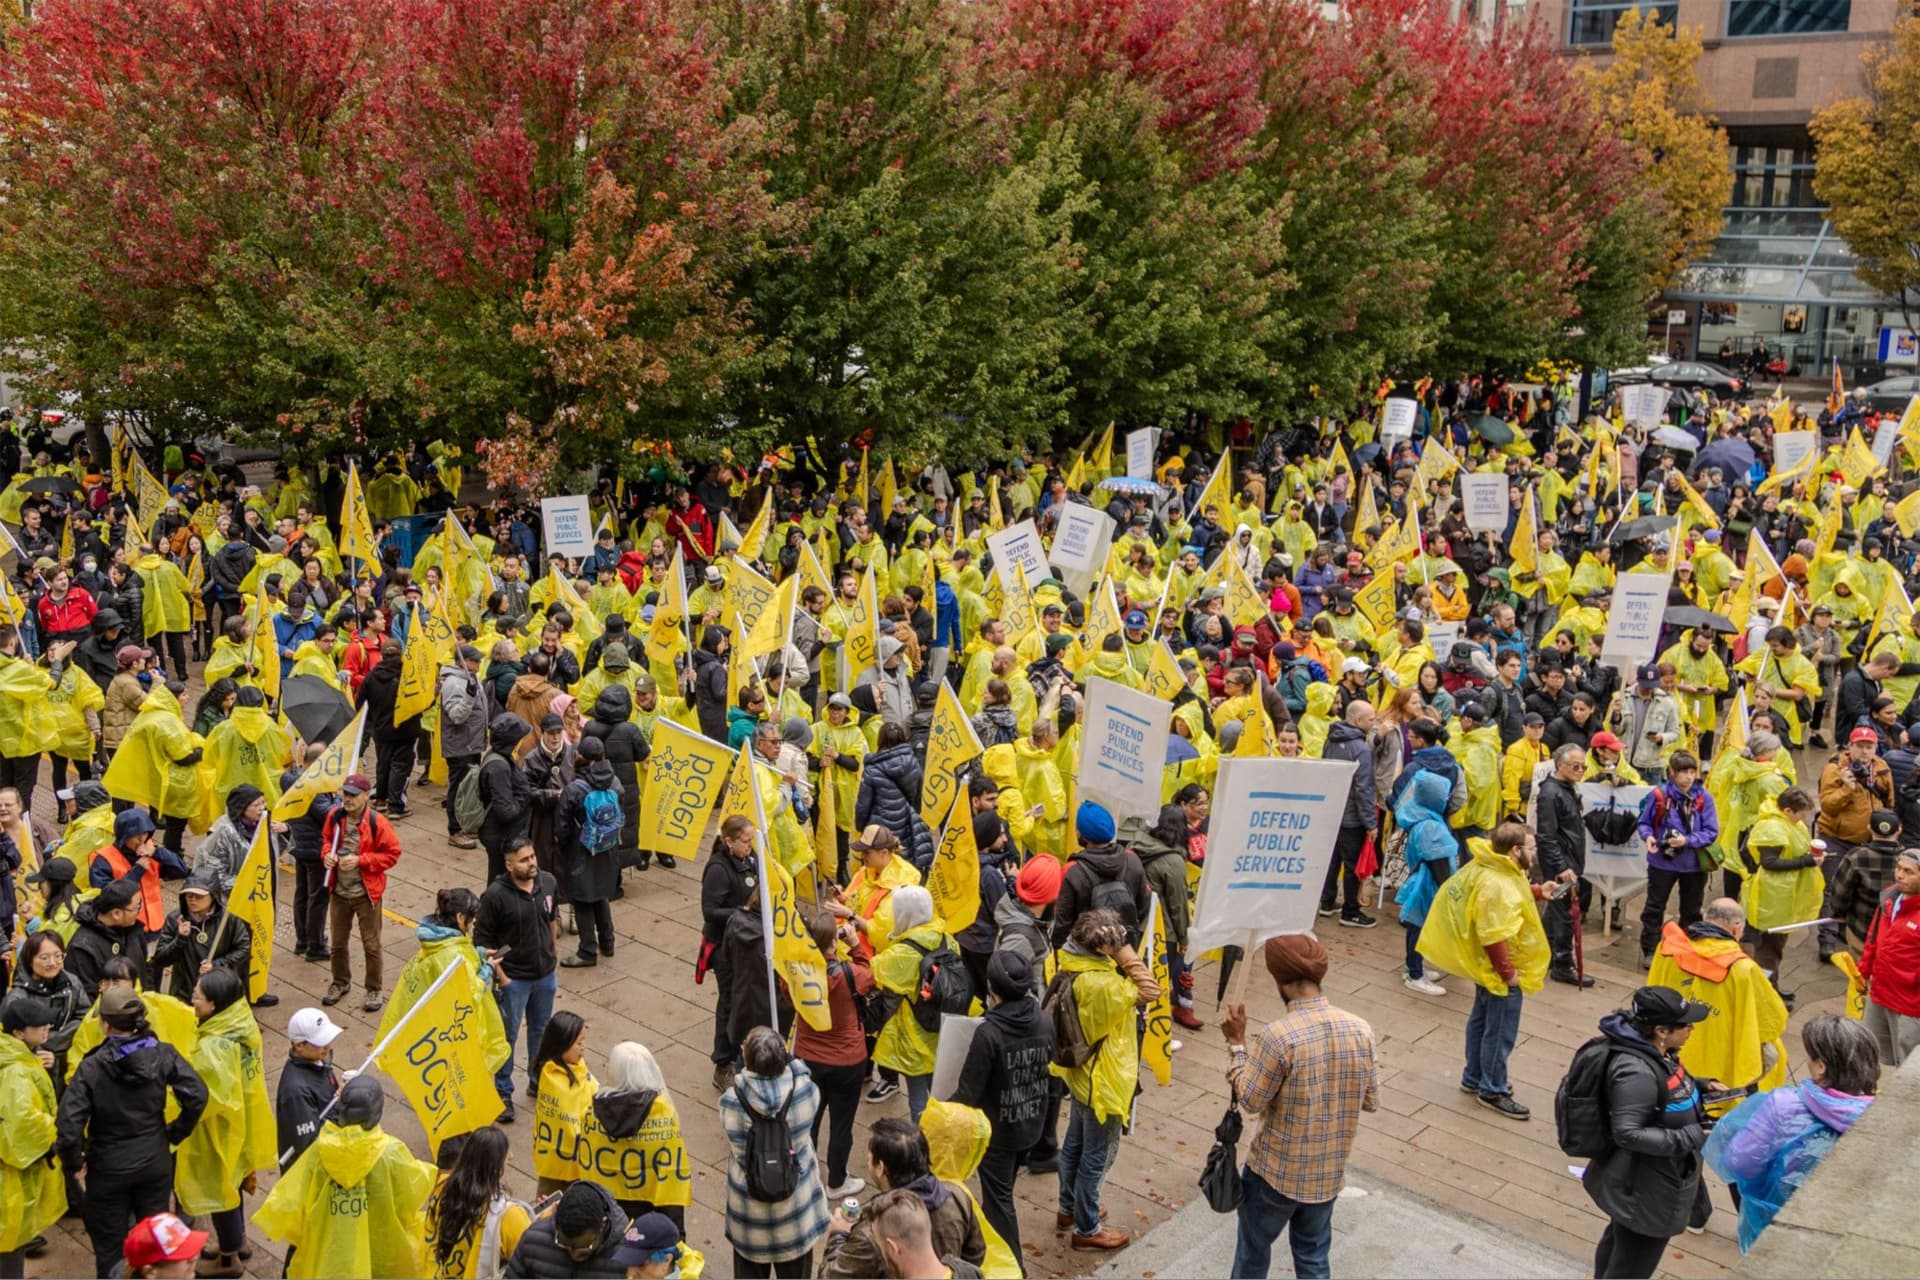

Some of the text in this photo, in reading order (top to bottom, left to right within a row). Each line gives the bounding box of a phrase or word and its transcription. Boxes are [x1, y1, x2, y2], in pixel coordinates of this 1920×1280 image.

[1006, 542, 1029, 557] DEFEND
[1108, 718, 1144, 742] DEFEND
[1107, 733, 1141, 756] PUBLIC
[1100, 745, 1144, 772] SERVICES
[1249, 811, 1310, 829] DEFEND
[1247, 833, 1303, 852] PUBLIC
[1233, 855, 1306, 874] SERVICES
[1008, 1048, 1048, 1069] LANDIN
[1000, 1100, 1041, 1122] PLANET
[296, 1121, 315, 1136] HH
